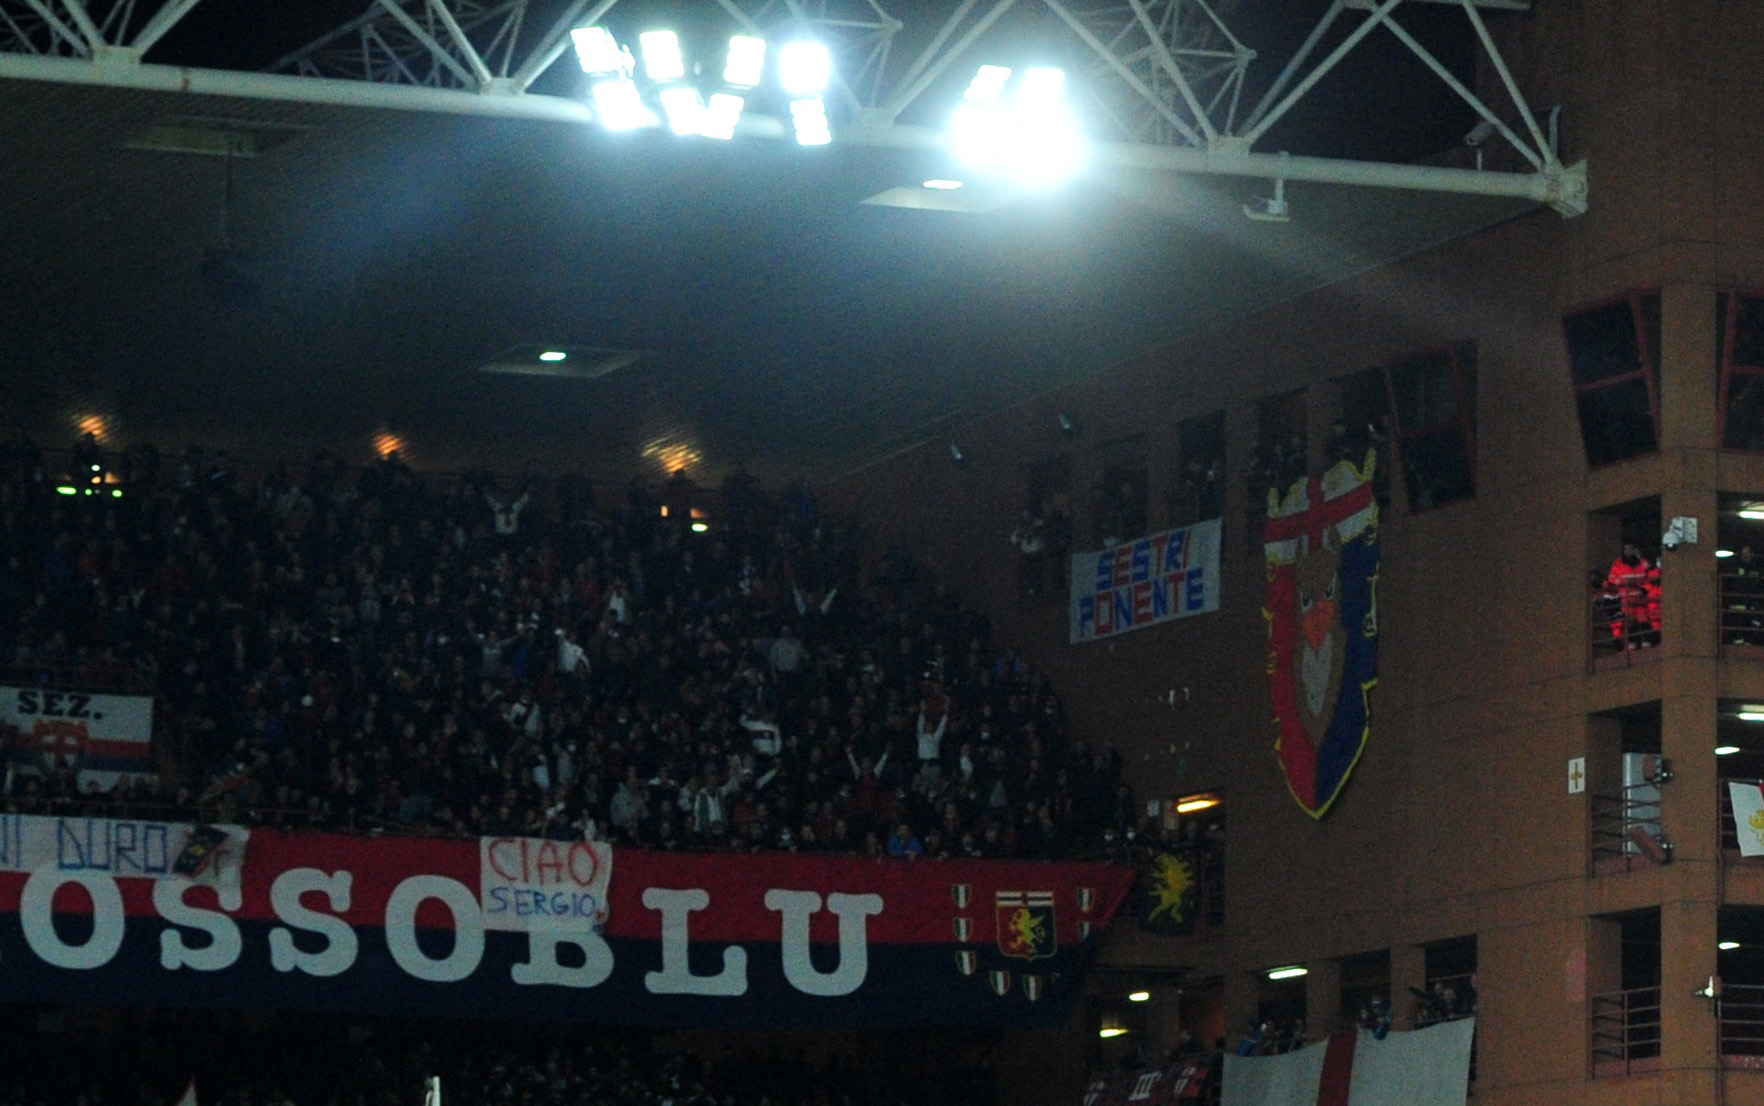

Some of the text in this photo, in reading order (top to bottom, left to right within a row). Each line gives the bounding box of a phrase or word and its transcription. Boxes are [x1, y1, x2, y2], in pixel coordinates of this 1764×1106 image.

[1096, 529, 1191, 591] SESTRI
[1079, 567, 1204, 637] PONENTE
[18, 690, 104, 720] SEZ.
[487, 840, 598, 886] CIAO
[488, 886, 597, 918] SERGIO
